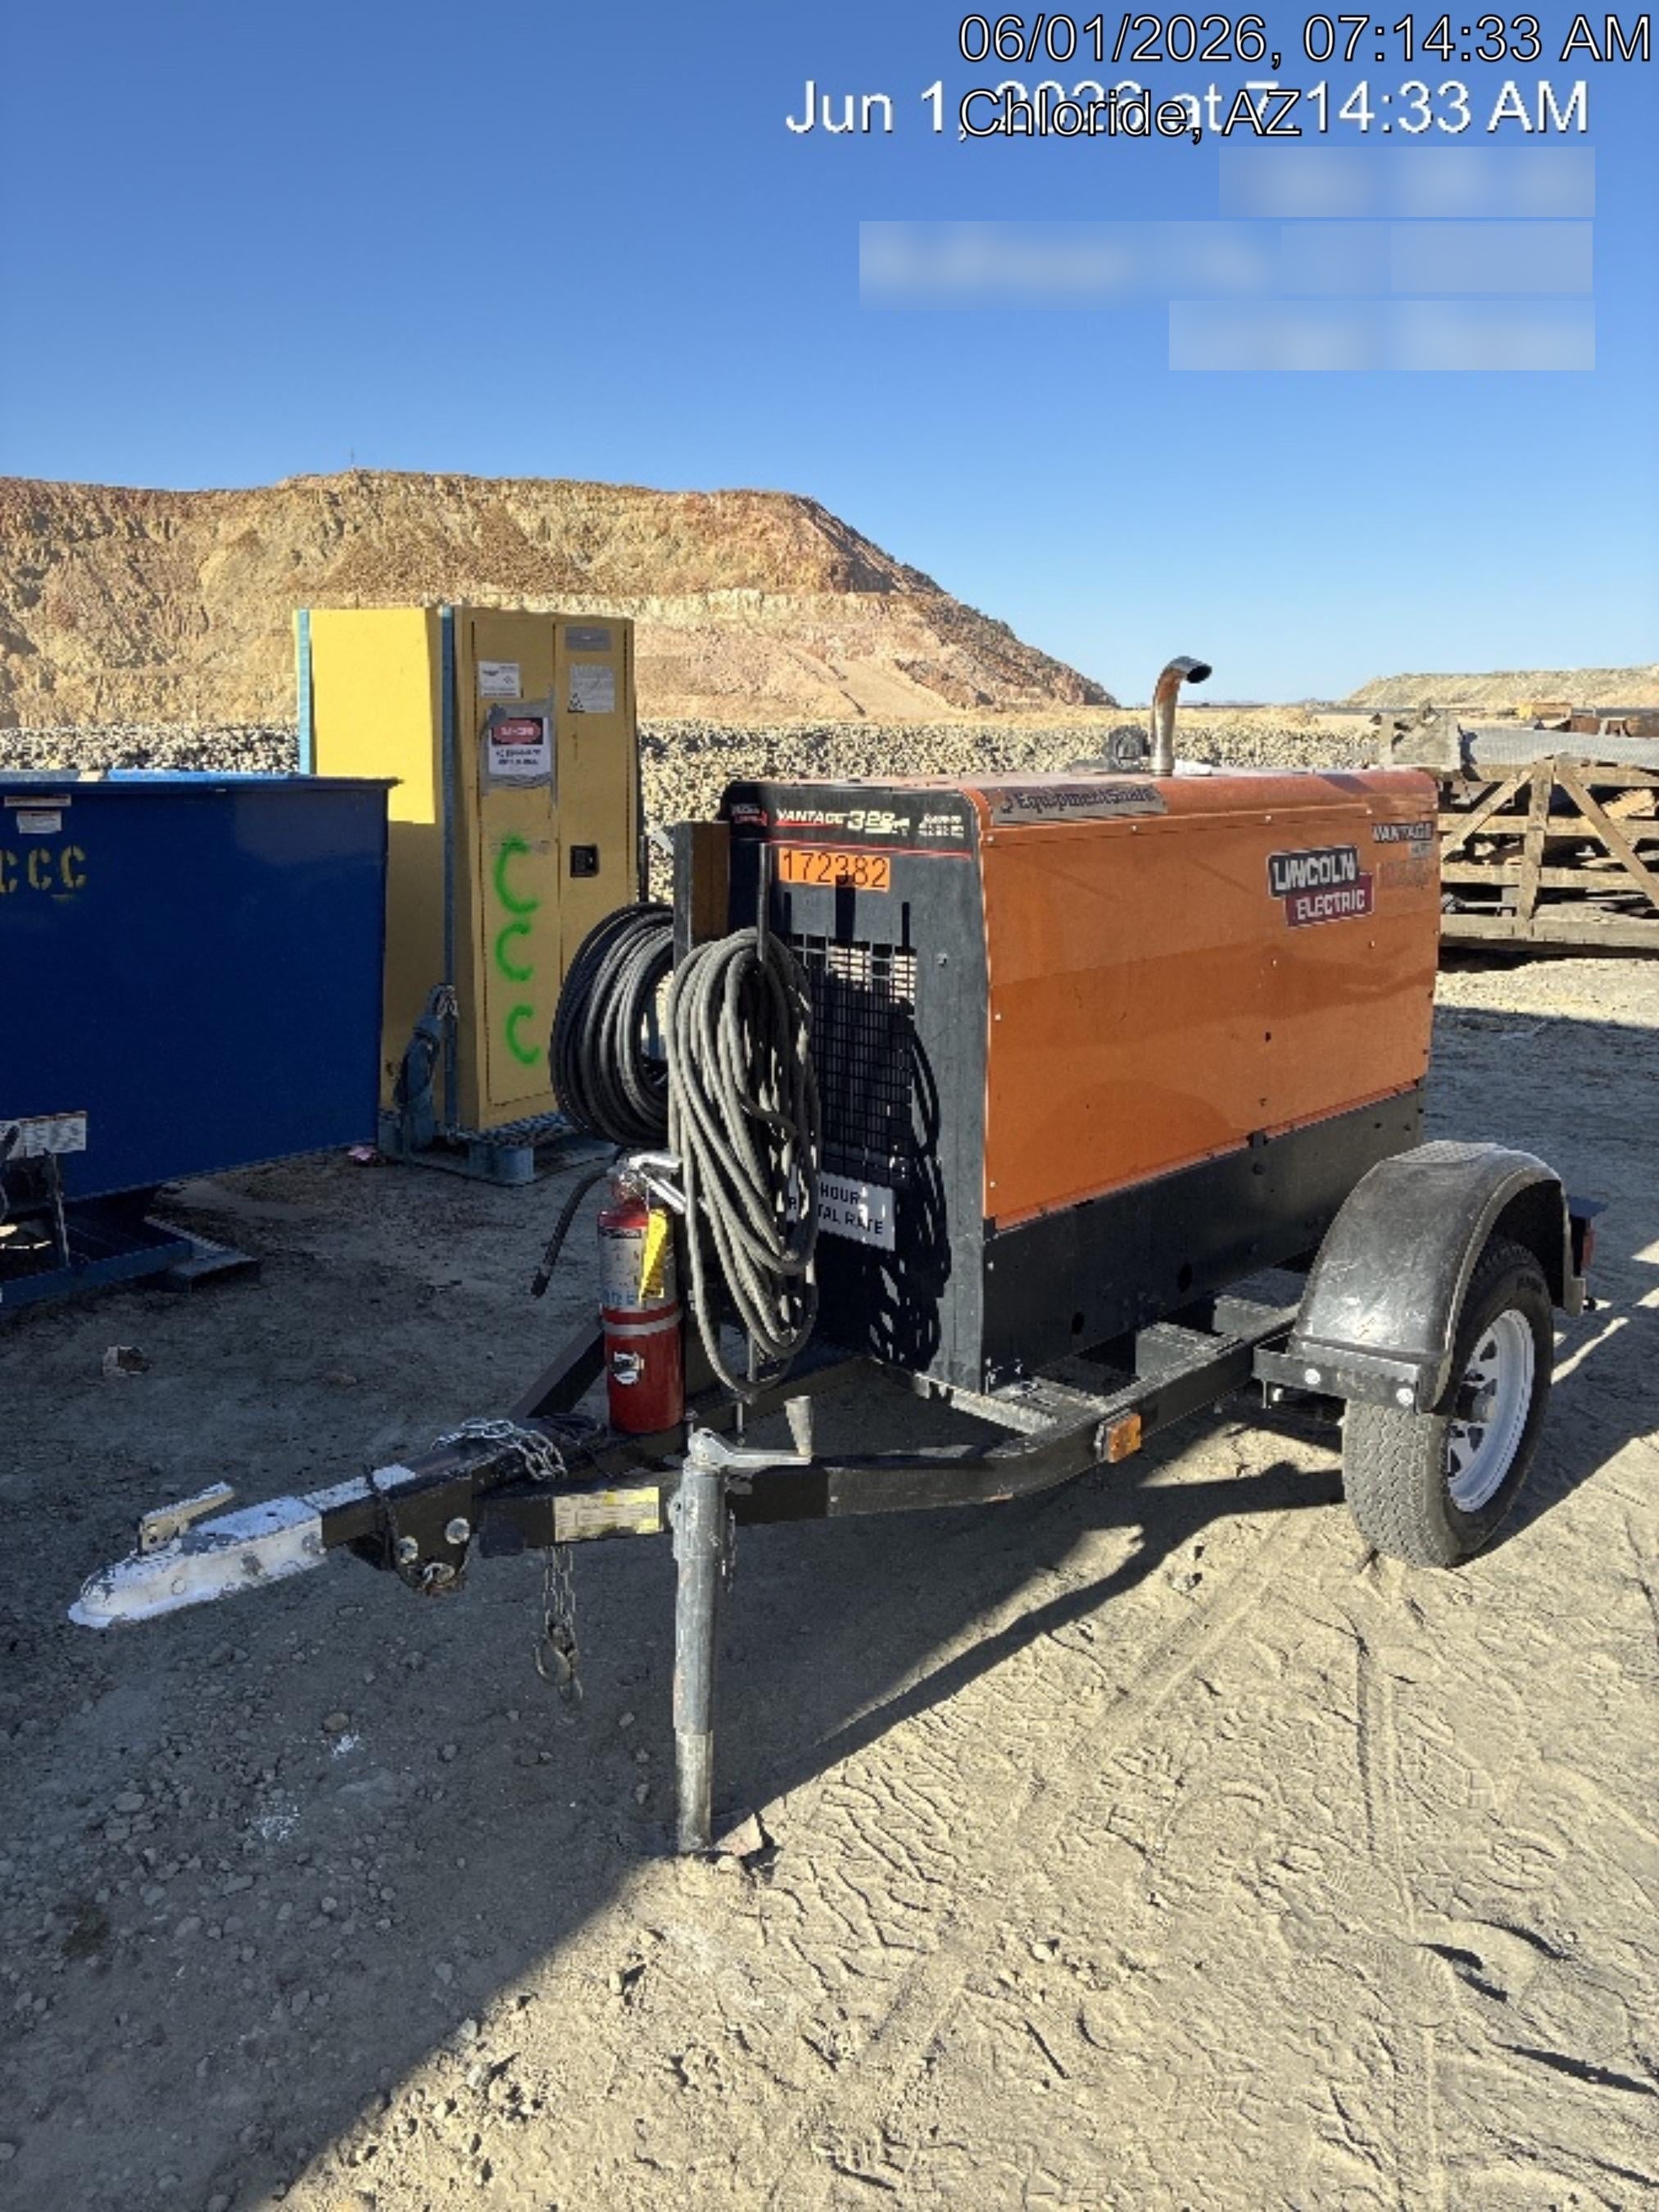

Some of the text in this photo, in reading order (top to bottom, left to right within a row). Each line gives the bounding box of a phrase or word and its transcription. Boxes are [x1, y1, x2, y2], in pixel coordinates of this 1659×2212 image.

[782, 851, 889, 889] 172382
[1272, 852, 1357, 891] LINCOLN
[1296, 888, 1367, 920] ELECTRIC
[820, 1181, 861, 1206] HOUR
